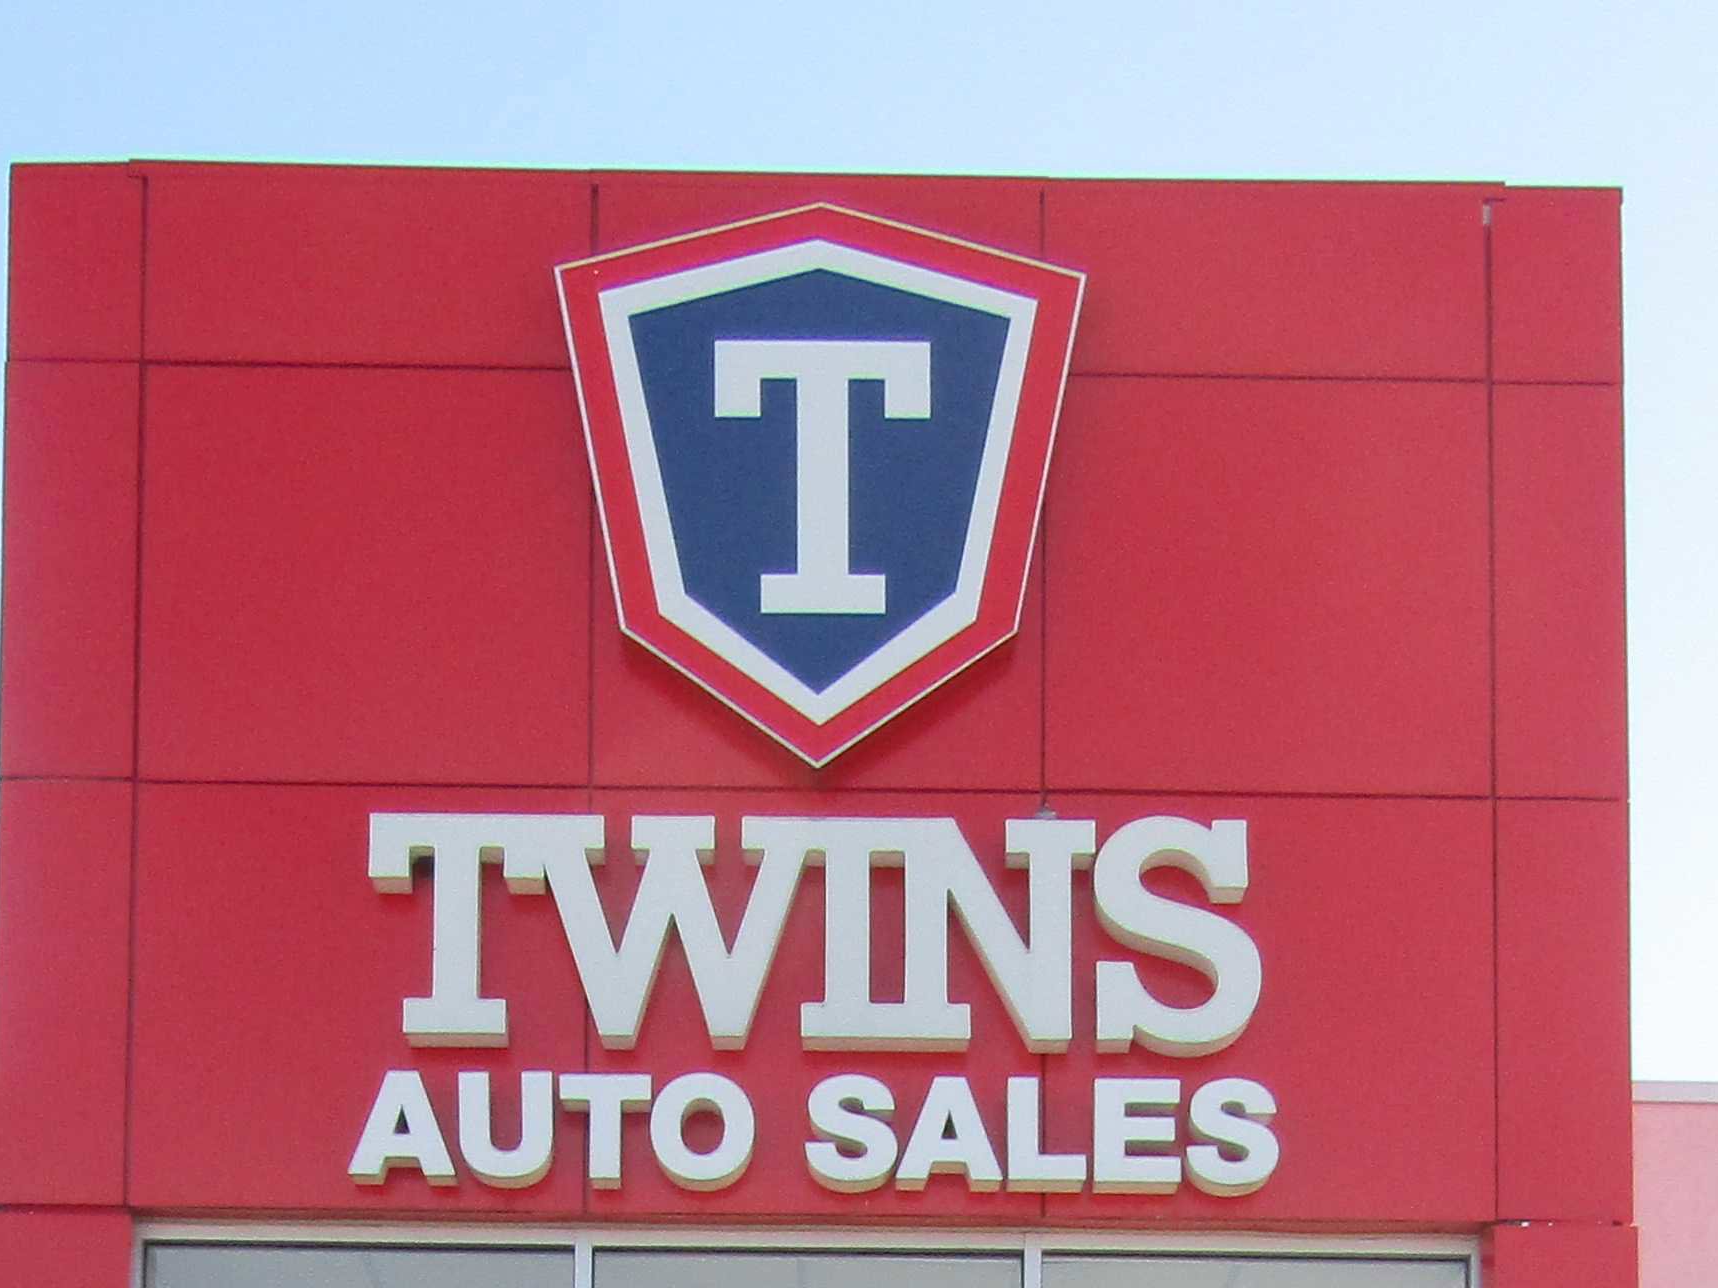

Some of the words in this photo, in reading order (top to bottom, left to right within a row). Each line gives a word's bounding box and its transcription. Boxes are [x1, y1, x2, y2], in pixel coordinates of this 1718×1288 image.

[714, 340, 931, 614] T
[368, 813, 1263, 1057] TWINS
[348, 1070, 756, 1192] AUTO
[804, 1073, 1280, 1197] SALES
